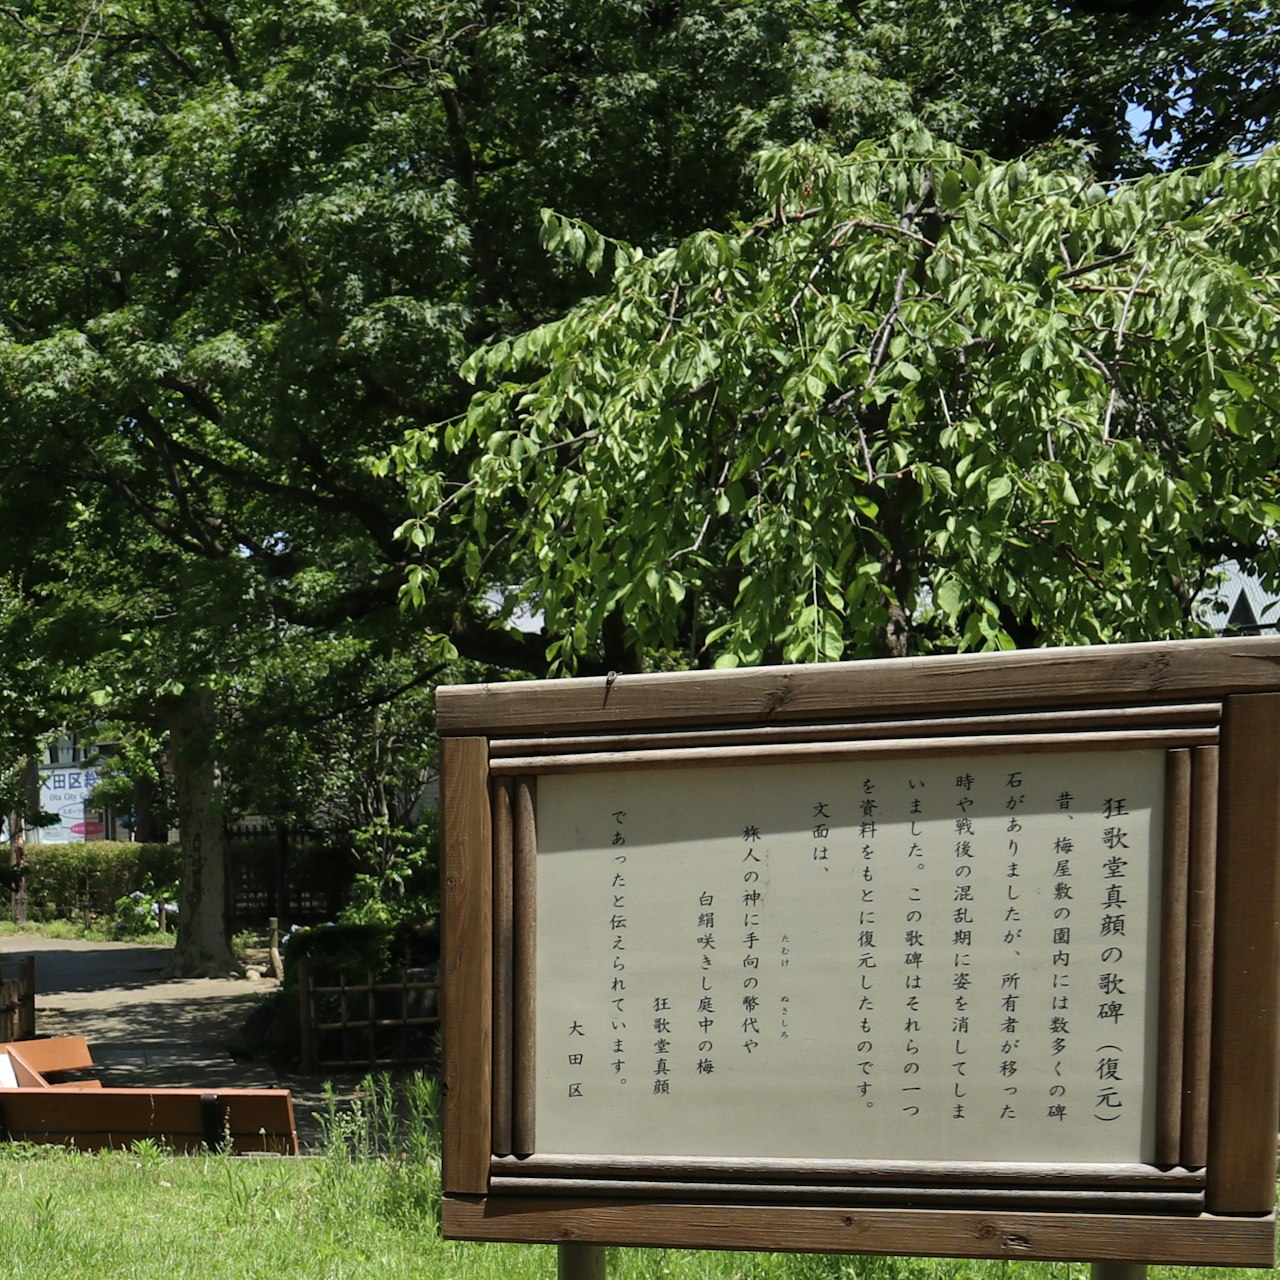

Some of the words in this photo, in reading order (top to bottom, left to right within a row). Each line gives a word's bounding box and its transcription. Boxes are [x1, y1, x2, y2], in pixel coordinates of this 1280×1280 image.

[64, 792, 78, 801] City
[812, 801, 831, 872] 文面は、
[609, 810, 627, 1084] であったと伝えられています。
[653, 997, 671, 1095] 狂歌堂真顔
[696, 890, 716, 1075] 白絹咲きし庭中の梅
[780, 934, 790, 967] たむけ
[857, 778, 879, 1108] を資料をもとに復元したものです。
[901, 779, 925, 1116] いました。この歌碑はそれらの一つ
[952, 772, 975, 1119] 時や戦後の混乱期に姿を消してしま
[999, 771, 1025, 1119] 石がありましたが、所有者が移った
[1047, 790, 1075, 1122] 昔、梅屋敷の園内には数多くの碑
[568, 1020, 585, 1098] 大田区
